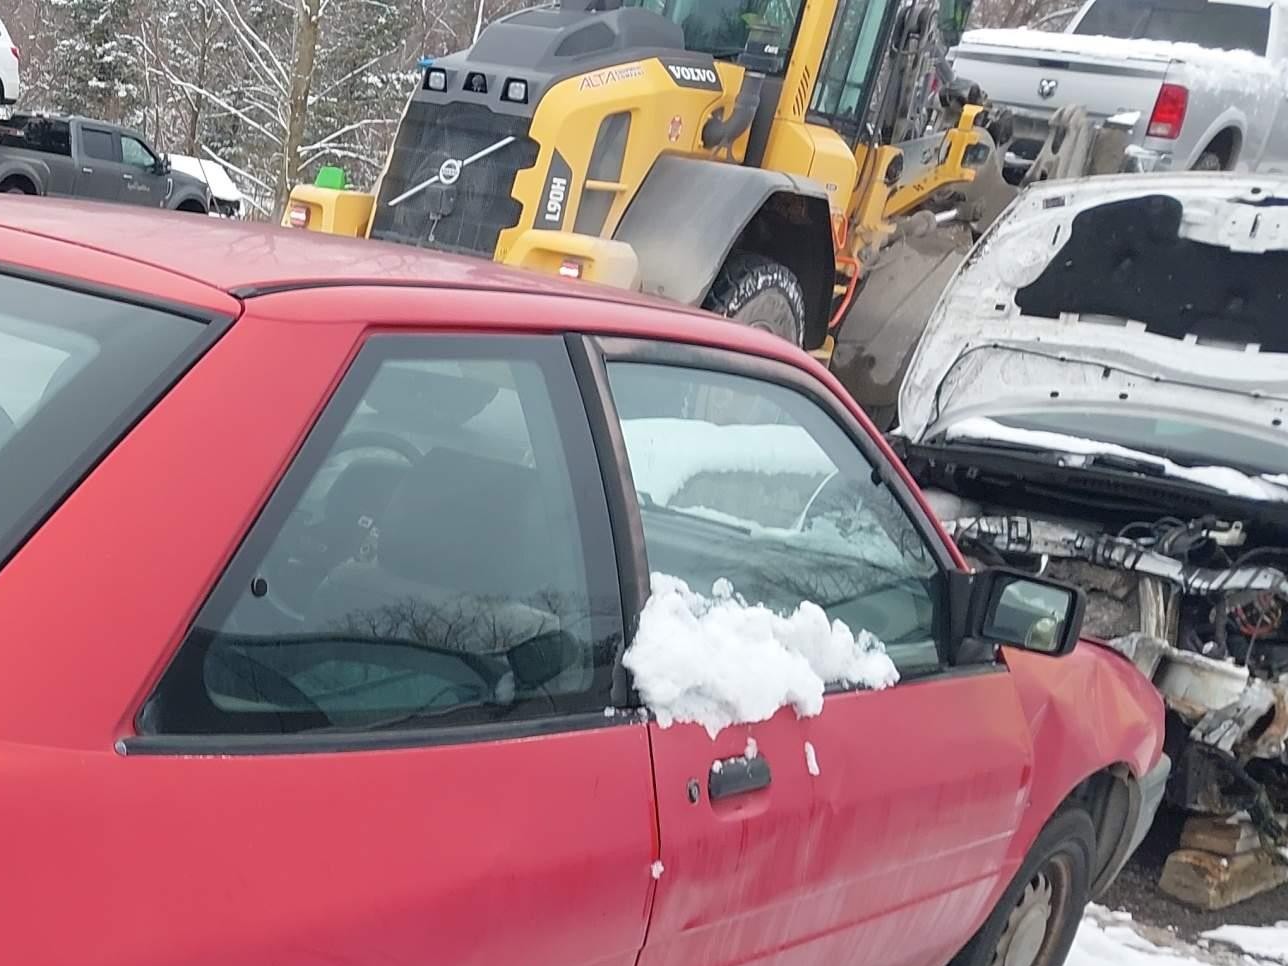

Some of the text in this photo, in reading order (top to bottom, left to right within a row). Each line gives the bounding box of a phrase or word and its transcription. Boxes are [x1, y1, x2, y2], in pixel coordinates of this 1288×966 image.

[579, 70, 617, 92] ALTA
[668, 65, 716, 83] VOLVO
[545, 177, 567, 221] L90H
